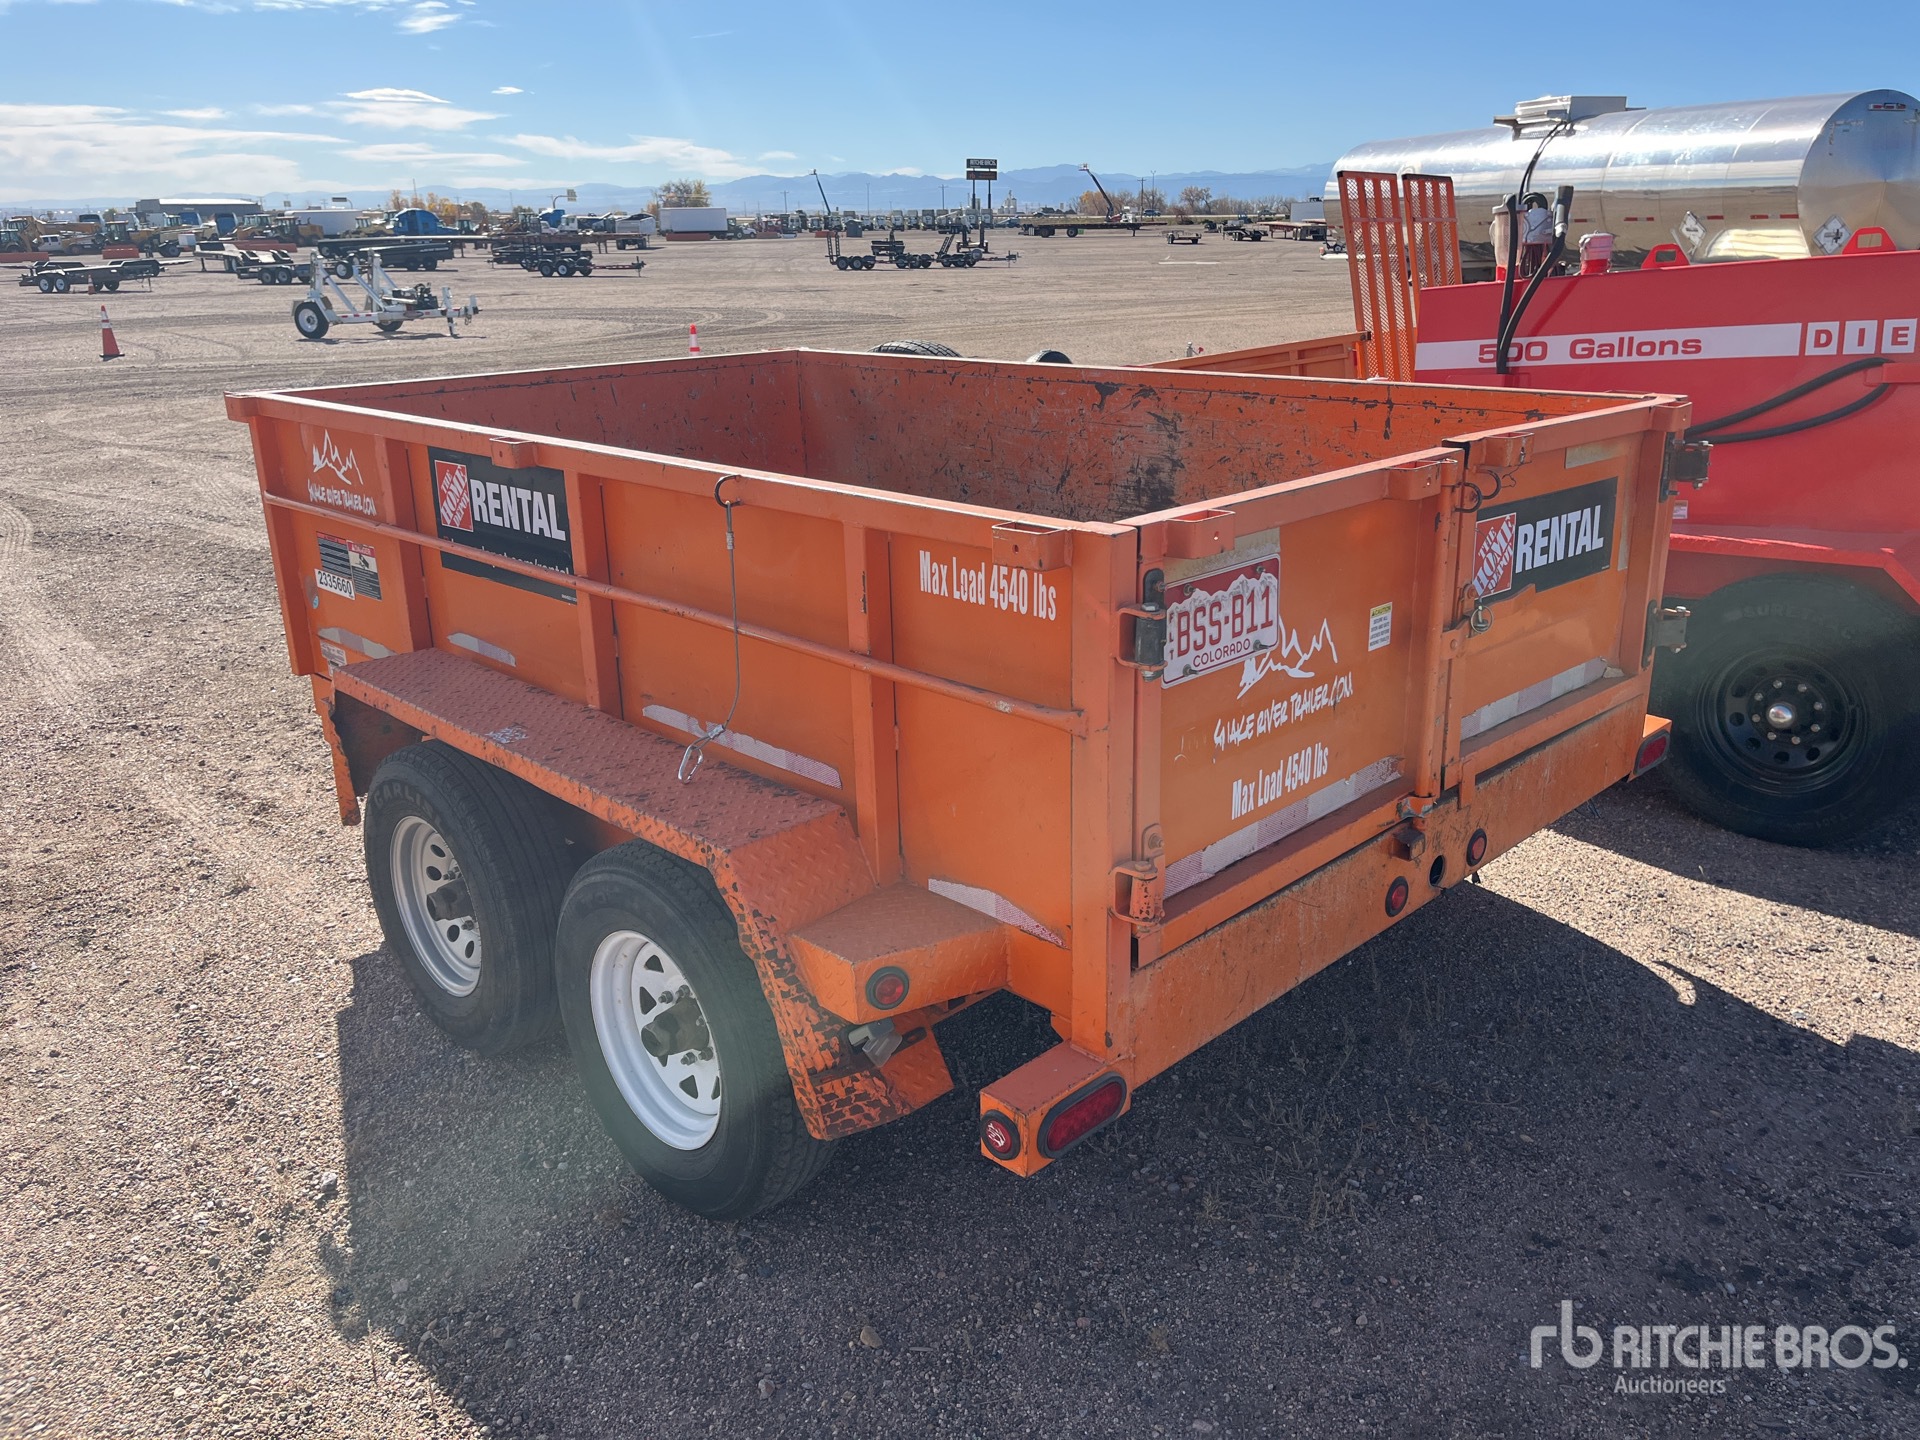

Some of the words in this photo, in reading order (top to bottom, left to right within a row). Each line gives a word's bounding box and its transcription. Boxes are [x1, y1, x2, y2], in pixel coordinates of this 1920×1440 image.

[1478, 341, 1548, 363] 500
[1569, 336, 1702, 360] Gallons
[441, 469, 453, 494] THE
[441, 465, 467, 525] HOME
[453, 490, 470, 527] DEPOT
[470, 479, 566, 541] RENTAL
[1472, 514, 1516, 596] HOME
[1478, 526, 1497, 559] THE
[1515, 505, 1604, 573] RENTAL
[318, 570, 352, 595] 2335660
[919, 550, 948, 597] Max
[952, 556, 985, 606] Load
[989, 564, 1028, 615] 4540
[1033, 572, 1056, 621] lbs
[1487, 541, 1514, 594] DEPOT
[1193, 638, 1251, 667] COLORADO
[1257, 699, 1288, 738] RIVER
[1232, 779, 1255, 820] Max
[1258, 760, 1284, 807] Load
[1285, 746, 1312, 793] 4540
[1313, 742, 1329, 779] lbs
